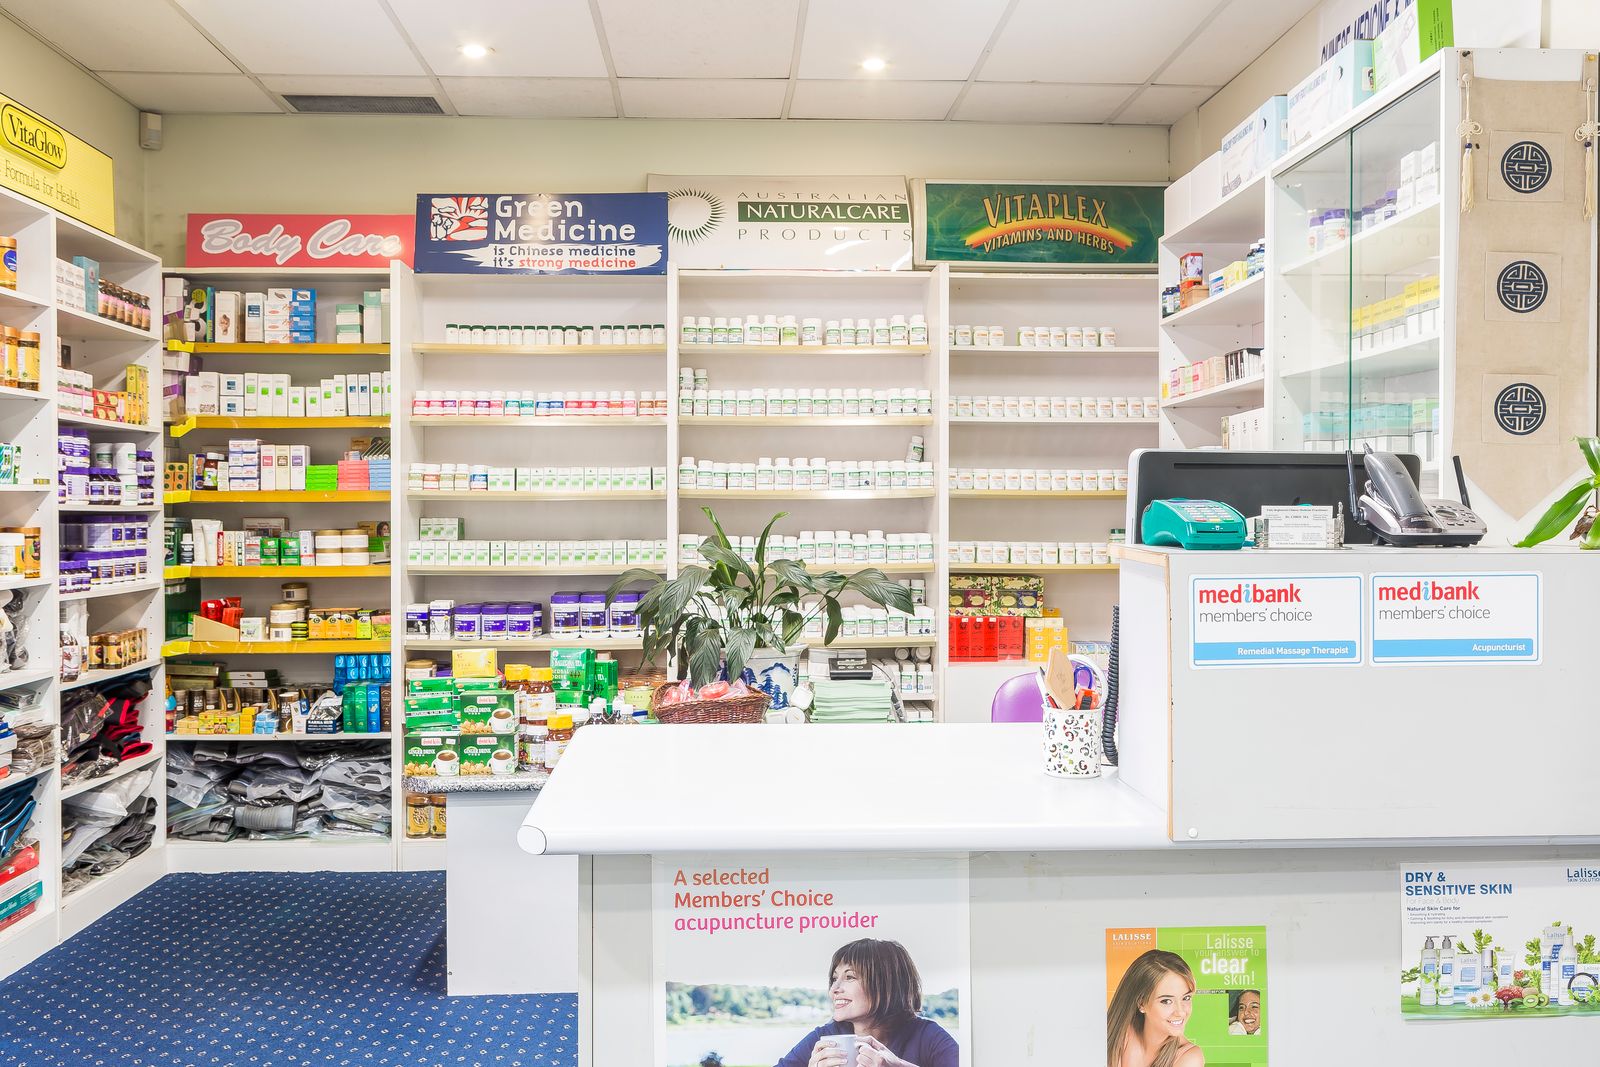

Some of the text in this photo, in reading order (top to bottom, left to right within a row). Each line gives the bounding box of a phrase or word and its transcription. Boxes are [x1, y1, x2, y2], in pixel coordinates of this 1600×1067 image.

[8, 113, 63, 160] VitaGlow
[5, 159, 80, 210] Formula for Health
[737, 191, 907, 200] AUSTRALIAN
[495, 196, 583, 218] Green
[747, 204, 902, 220] NATURALCARE
[983, 192, 1109, 229] VITAPLEX
[494, 219, 636, 241] Medicine
[737, 228, 912, 241] PRODUCTS
[201, 218, 402, 265] Body Care
[983, 227, 1115, 255] VITAMINS AND HERBS
[493, 245, 636, 256] is Chinese medicine
[492, 257, 636, 270] it's strong medicine
[1198, 583, 1302, 604] medibank
[1378, 581, 1480, 601] medibank
[1199, 607, 1313, 622] members' choice
[1378, 605, 1491, 620] members' choice
[1237, 646, 1349, 657] Remedial Massage Therapist
[1472, 643, 1526, 652] Acupuncturist
[673, 867, 770, 886] A selected
[1405, 871, 1446, 883] DRY &
[1405, 883, 1513, 896] SENSITIVE SKIN
[674, 889, 834, 908] Members’ Choice
[674, 912, 879, 934] acupuncture provider
[1112, 933, 1152, 941] LALISSE
[1206, 933, 1254, 949] Lalisse
[1215, 949, 1248, 957] answer
[1250, 948, 1260, 957] to
[1200, 952, 1249, 974] clear
[1223, 970, 1255, 986] skin!
